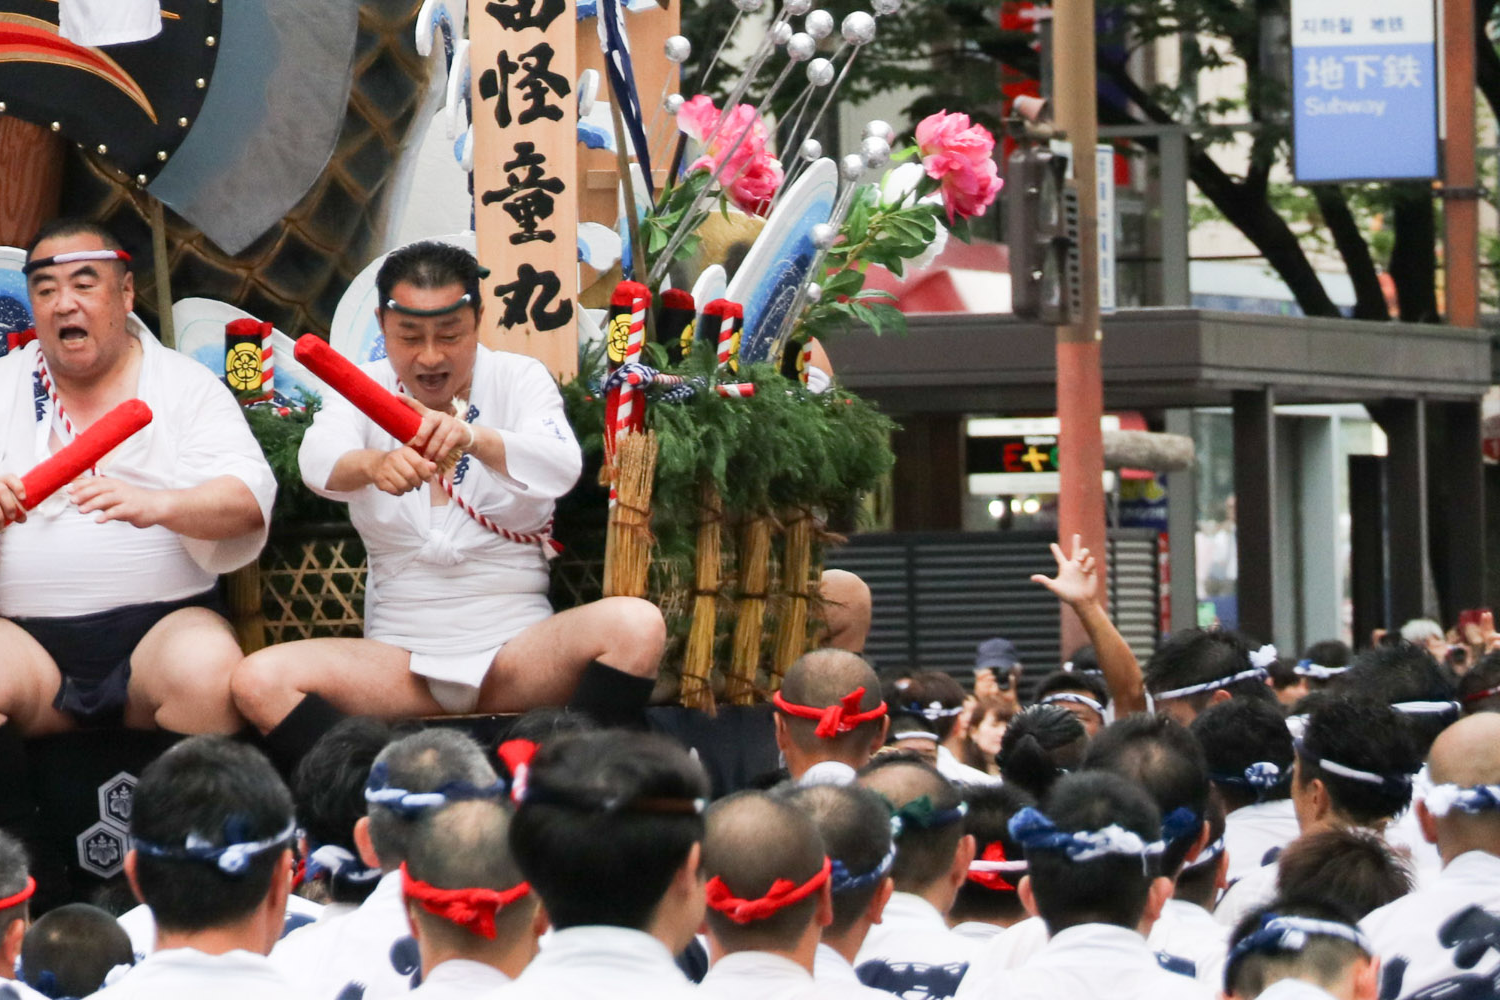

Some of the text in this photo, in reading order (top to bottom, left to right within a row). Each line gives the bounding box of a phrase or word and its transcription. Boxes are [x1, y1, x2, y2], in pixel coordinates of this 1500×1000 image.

[1304, 54, 1422, 90] 地下鉄
[1304, 96, 1387, 117] Subway
